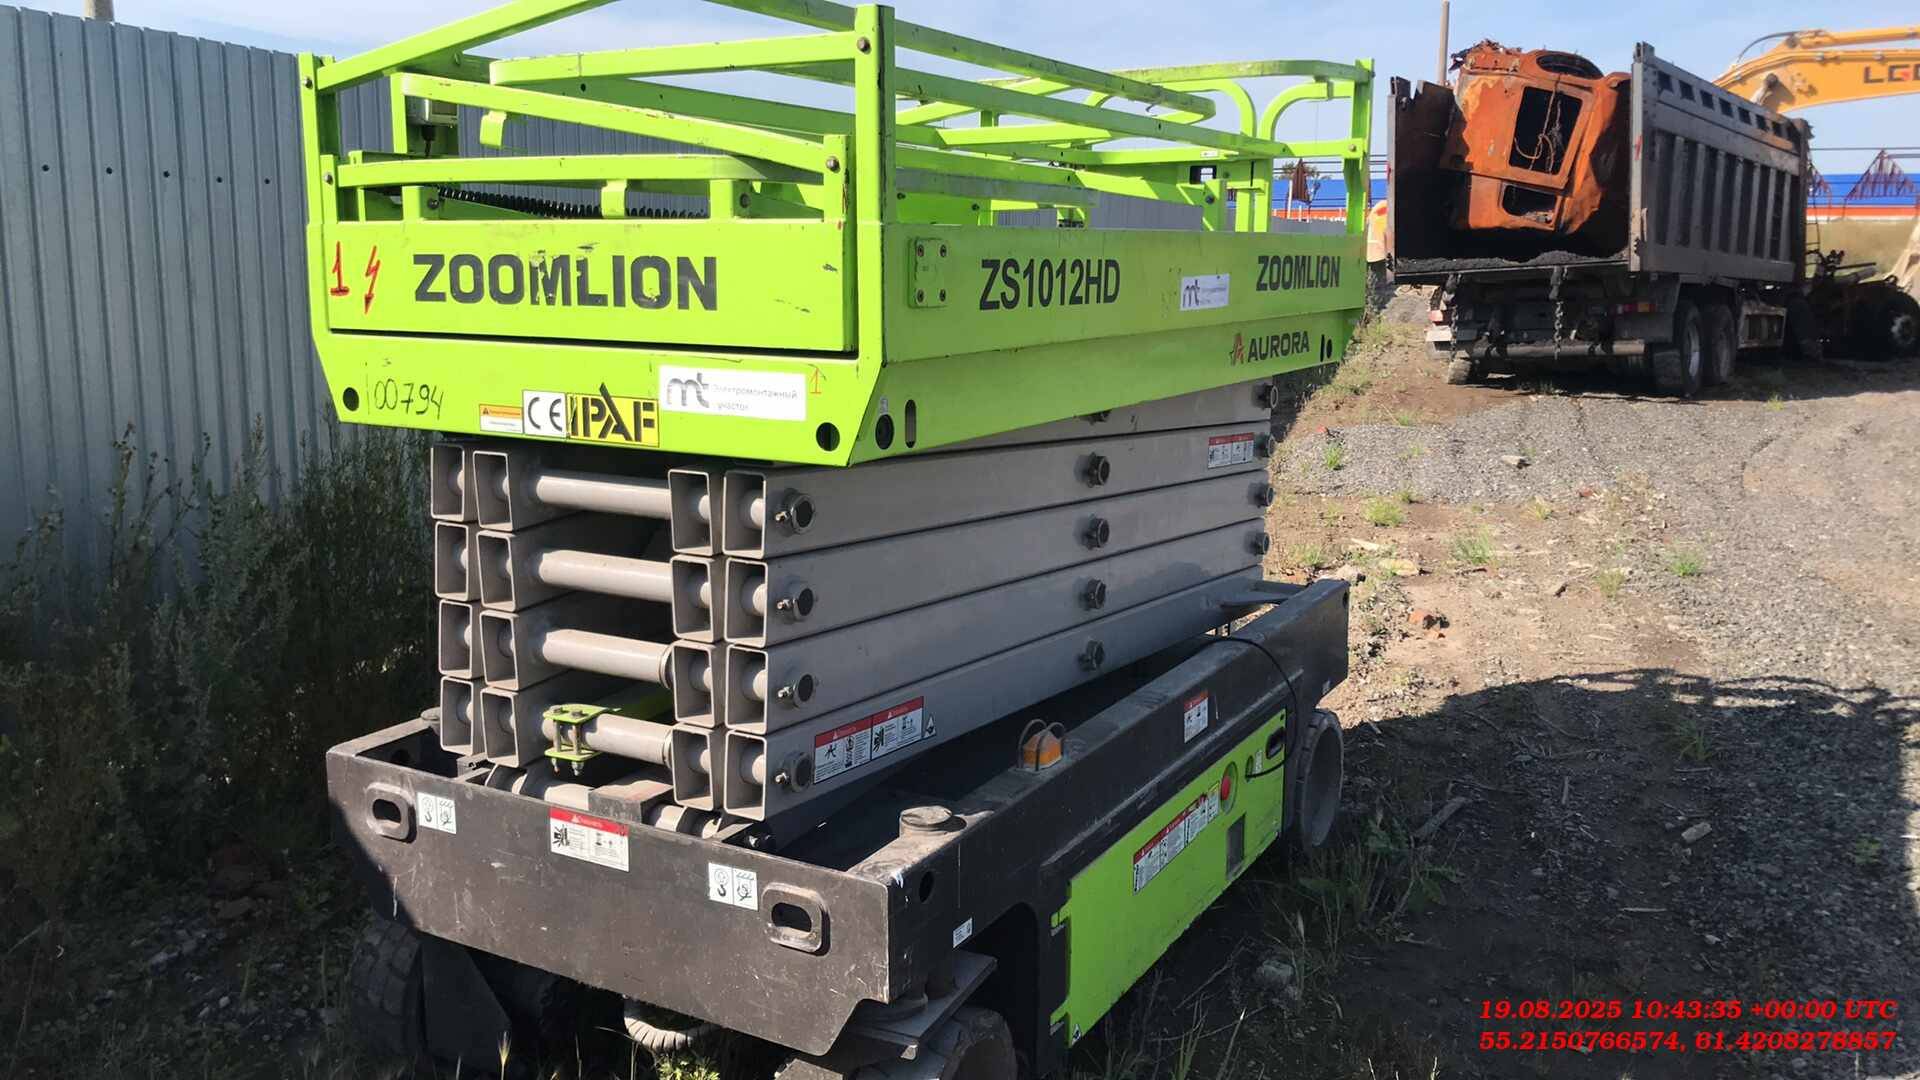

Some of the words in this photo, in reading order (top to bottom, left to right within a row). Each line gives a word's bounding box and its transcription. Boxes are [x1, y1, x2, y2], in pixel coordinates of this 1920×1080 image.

[412, 253, 718, 311] ZOOMLION
[979, 258, 1120, 310] ZS1012HD
[1256, 255, 1341, 291] ZOOMLION
[1247, 331, 1310, 363] AURORA
[374, 379, 444, 421] 00794
[527, 396, 563, 432] CE
[570, 381, 656, 442] IPAF
